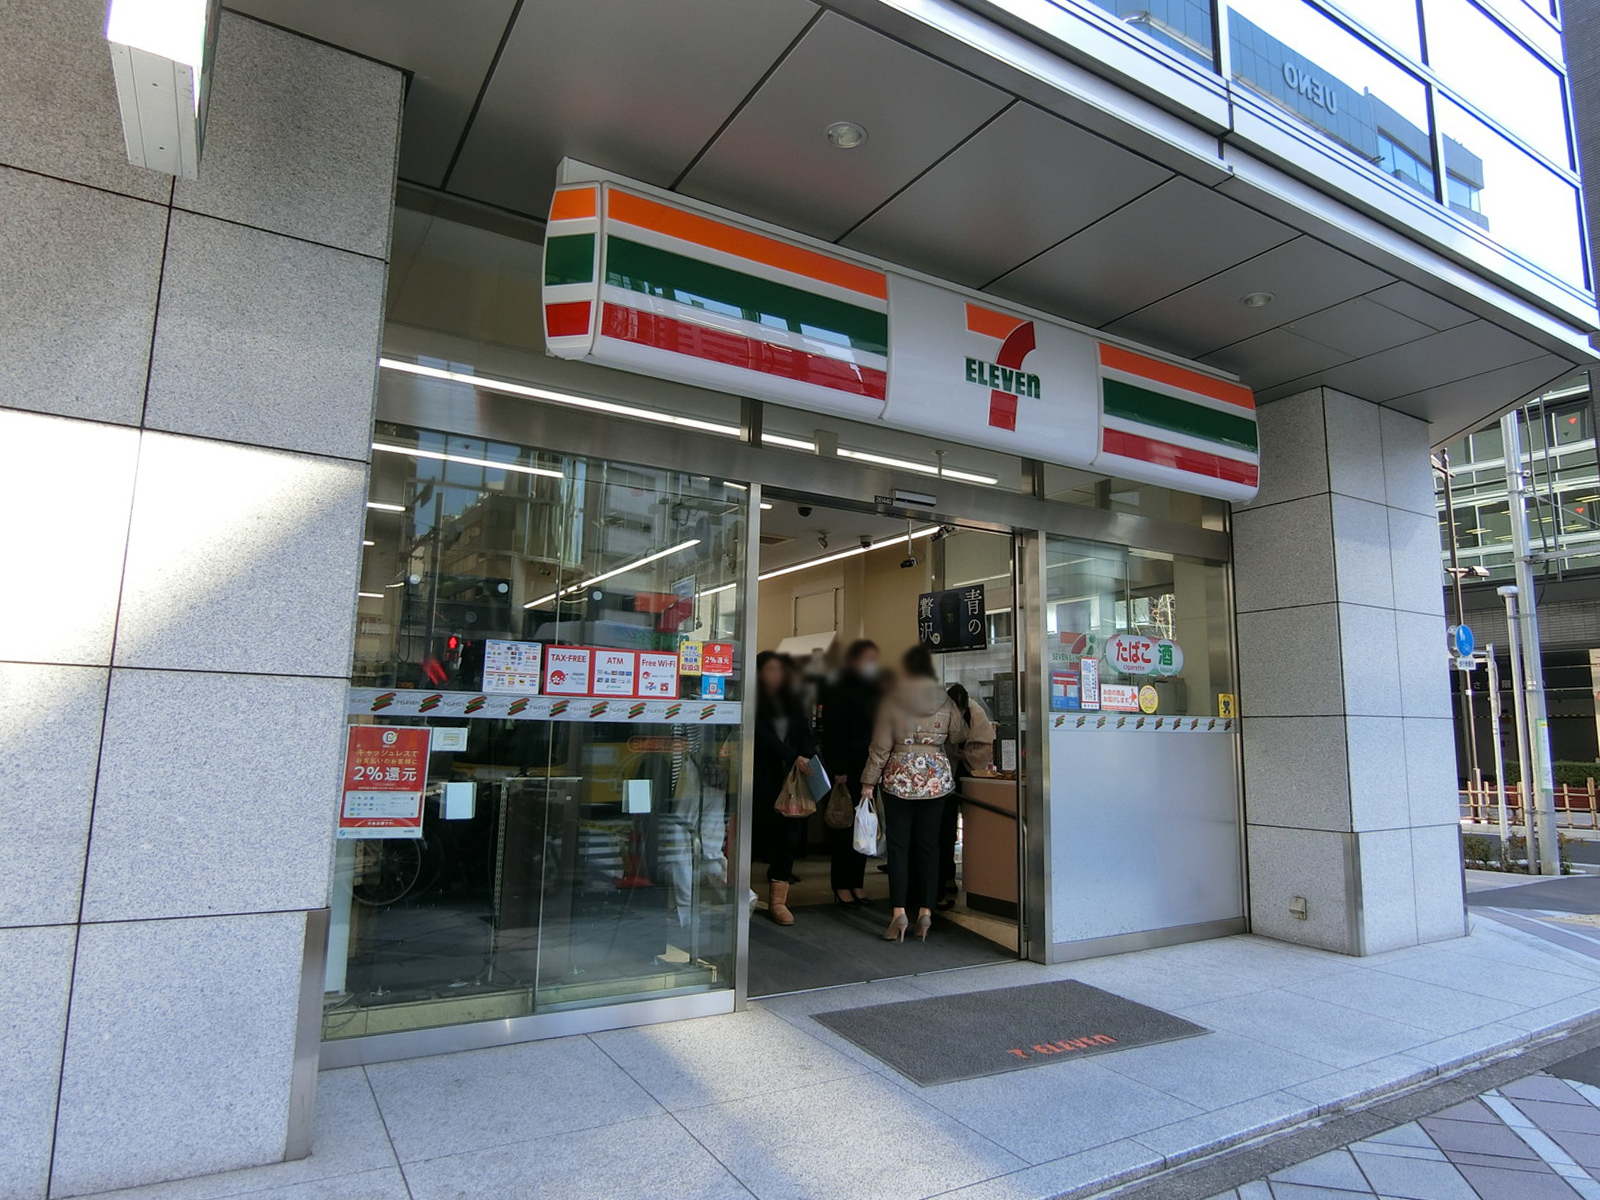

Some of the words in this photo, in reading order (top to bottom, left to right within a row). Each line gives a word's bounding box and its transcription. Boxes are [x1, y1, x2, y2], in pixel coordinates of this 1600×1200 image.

[963, 588, 983, 636] 青の
[550, 653, 587, 663] TAX-FREE
[1116, 640, 1152, 664] たばこ
[1158, 643, 1173, 666] 酒
[606, 657, 624, 665] ATM
[658, 661, 676, 669] Wi-Fi
[356, 749, 420, 758] キャッシュレスで
[353, 766, 417, 782] 2%還元
